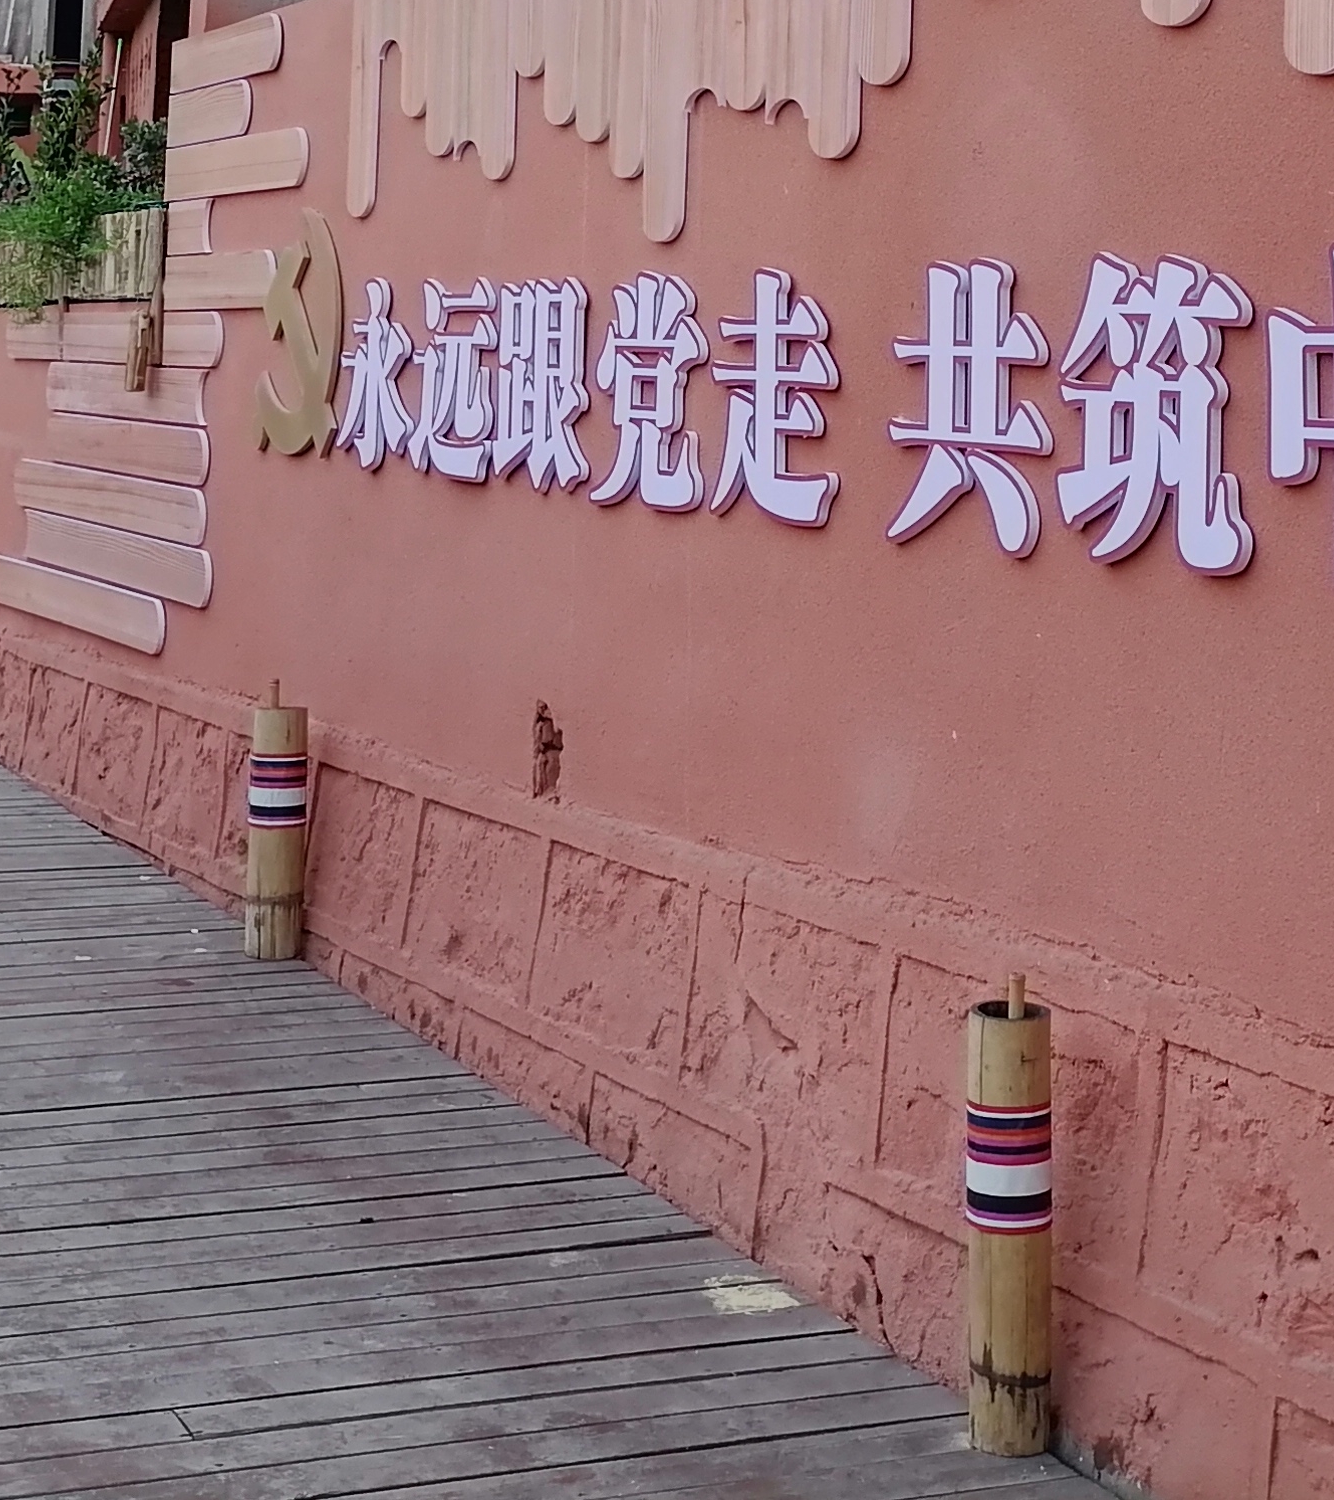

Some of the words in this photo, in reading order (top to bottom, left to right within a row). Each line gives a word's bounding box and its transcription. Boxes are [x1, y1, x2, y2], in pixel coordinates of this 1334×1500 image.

[336, 266, 841, 528] 永远跟党走
